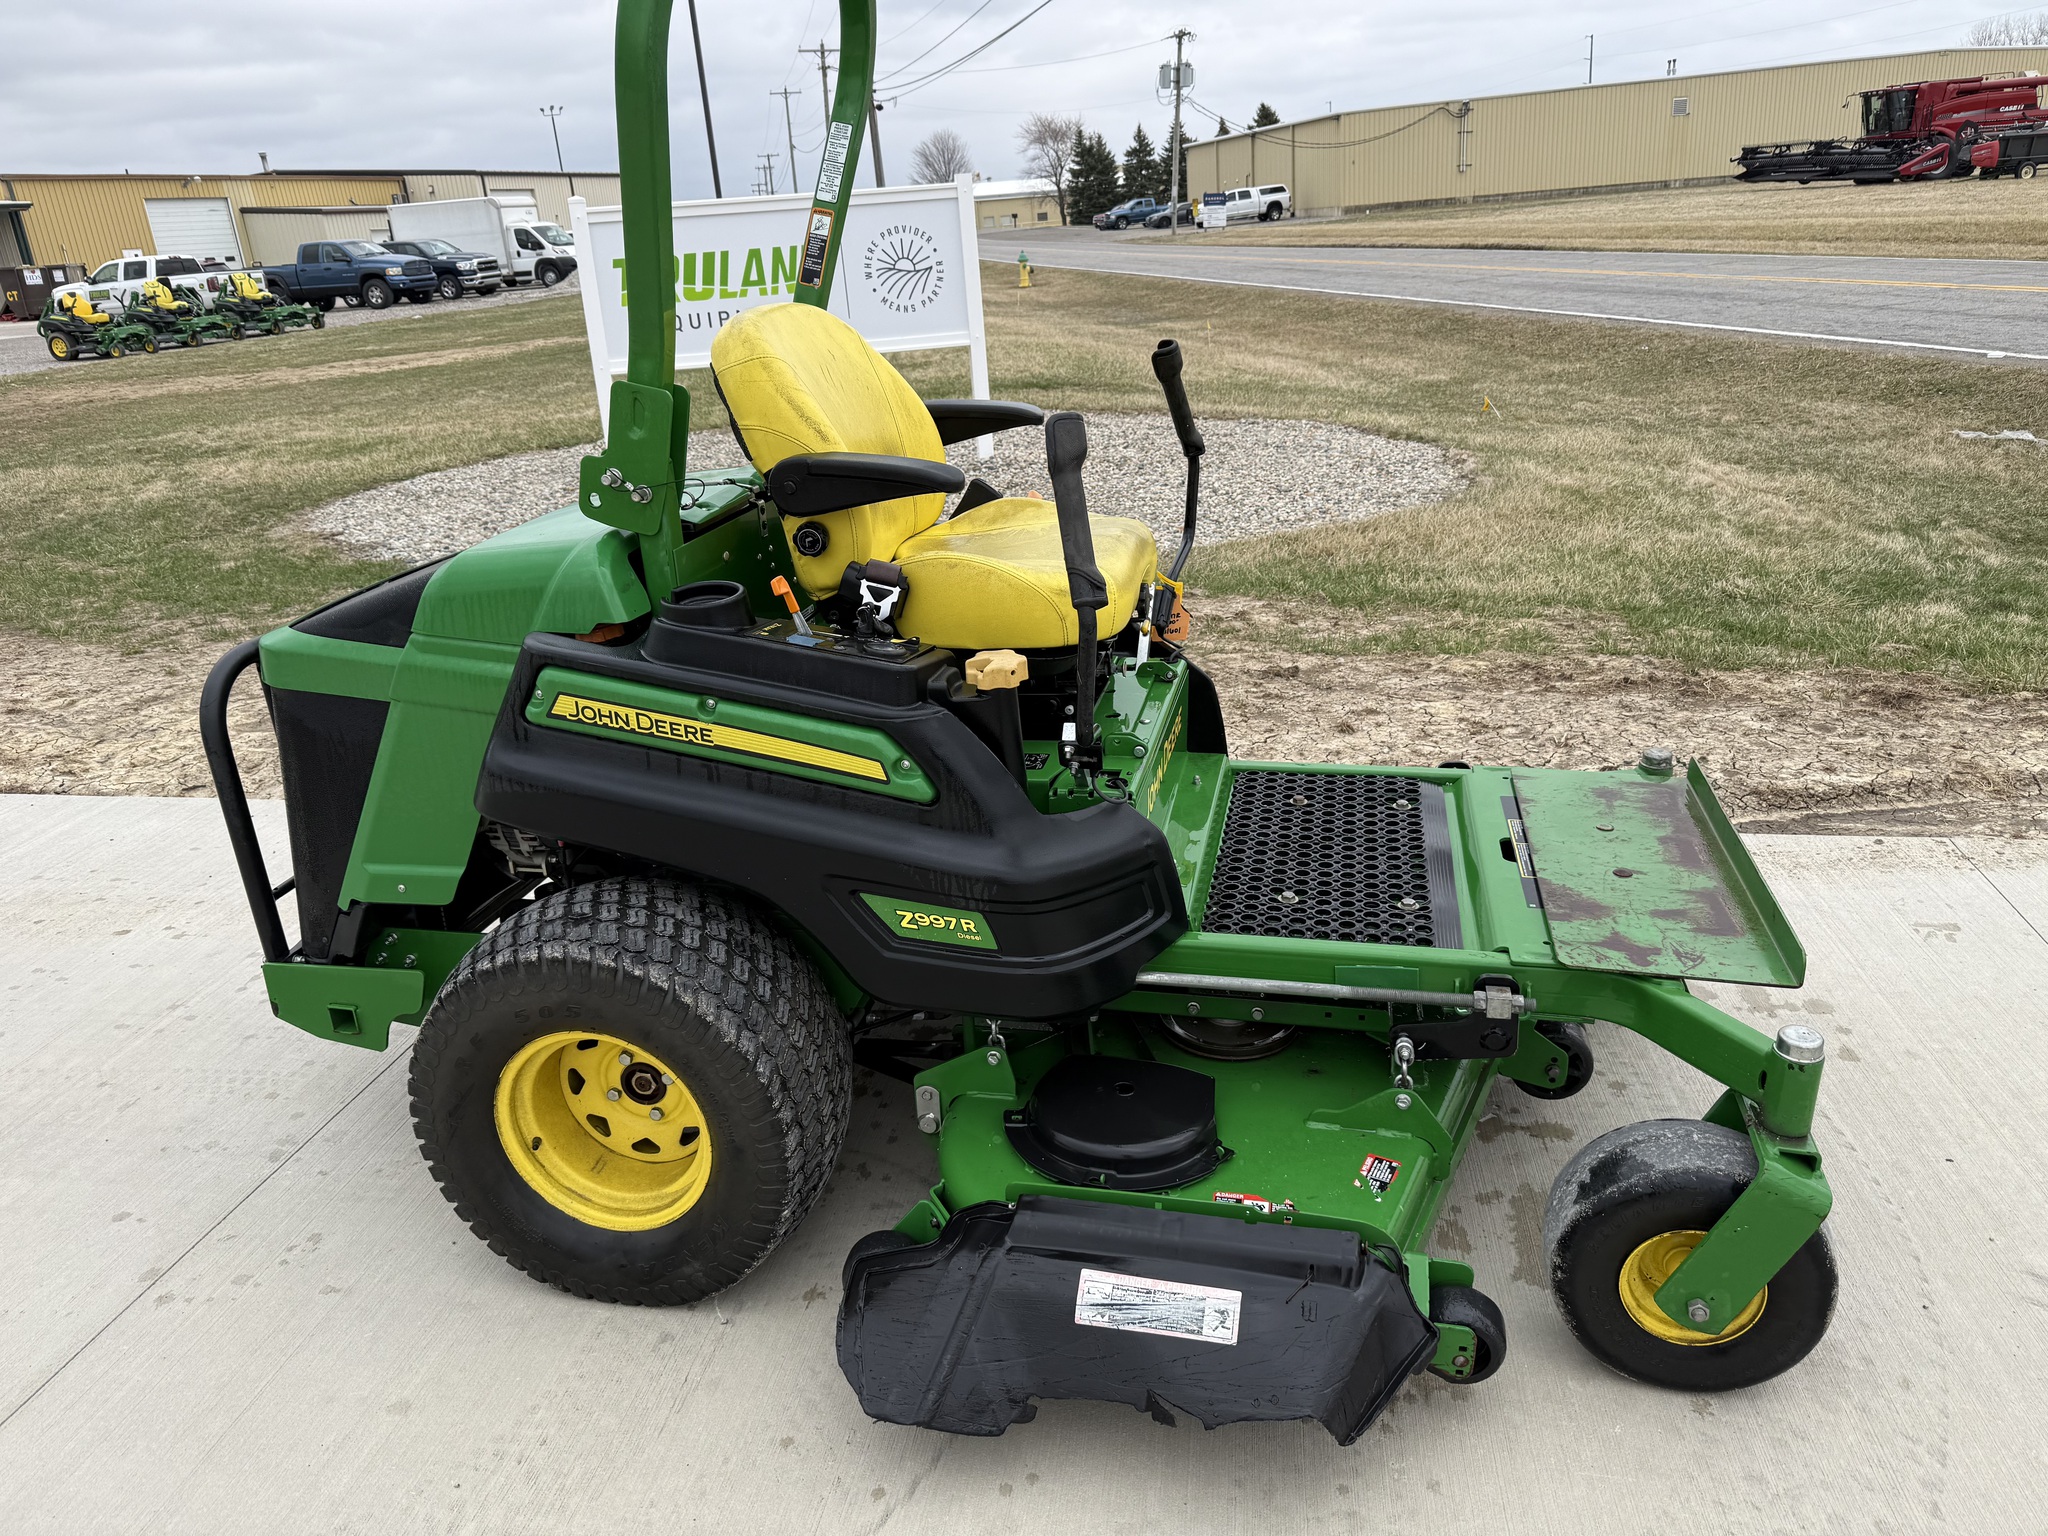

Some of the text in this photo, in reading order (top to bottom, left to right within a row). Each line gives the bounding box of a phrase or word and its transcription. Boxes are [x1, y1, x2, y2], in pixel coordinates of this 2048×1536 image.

[864, 224, 933, 280] WHERE PROVIDER
[6, 291, 19, 302] CT
[880, 260, 944, 313] MEANS PARTNER
[568, 700, 714, 744] JOHN DEERE
[1147, 706, 1183, 819] JOHN DEERE
[957, 932, 982, 941] Diesel
[1119, 1276, 1152, 1287] DANGER
